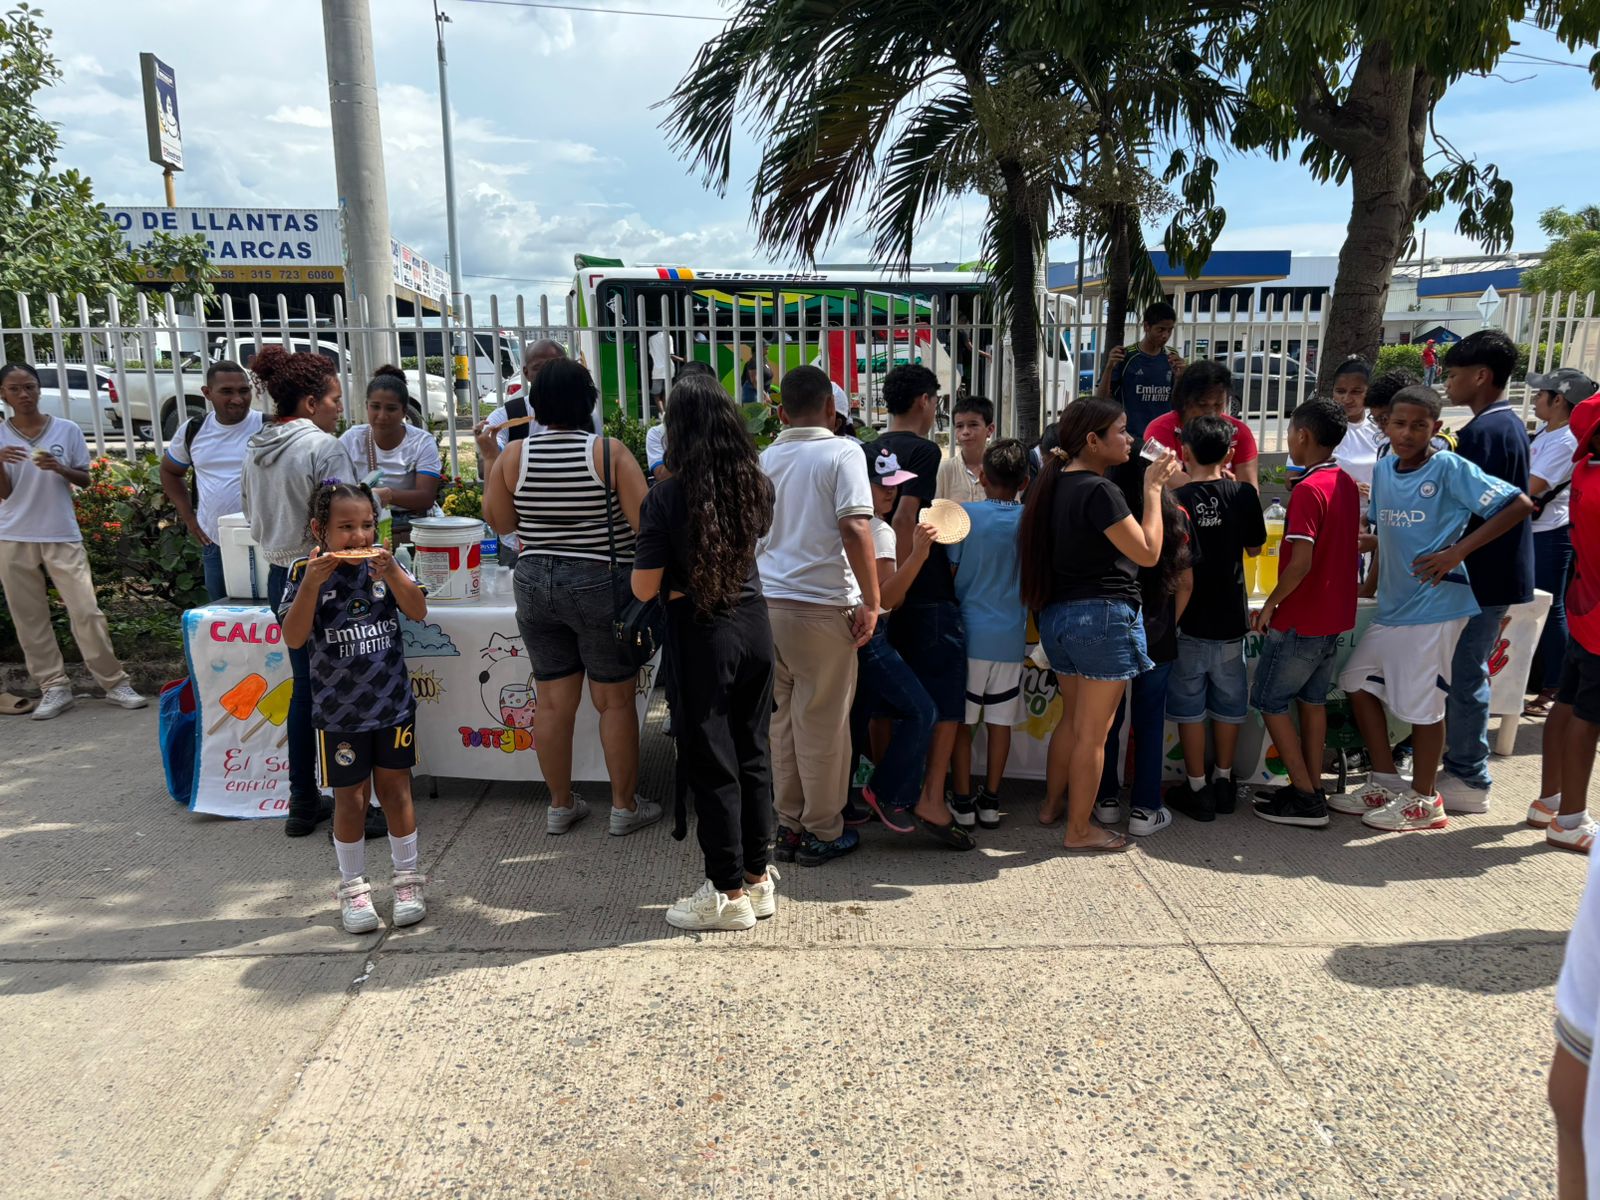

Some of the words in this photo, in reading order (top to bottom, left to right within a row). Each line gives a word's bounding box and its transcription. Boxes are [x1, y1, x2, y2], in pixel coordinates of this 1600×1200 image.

[142, 212, 178, 229] DE
[191, 213, 319, 232] LLANTAS
[251, 270, 272, 279] 315
[279, 270, 299, 280] 723
[307, 270, 335, 280] 6080
[1379, 509, 1426, 522] ETIHAD
[324, 617, 398, 644] Emirates
[339, 644, 357, 658] FLY
[359, 635, 393, 654] BETTER
[393, 723, 414, 749] 16
[223, 748, 251, 778] El
[225, 775, 278, 792] enfria
